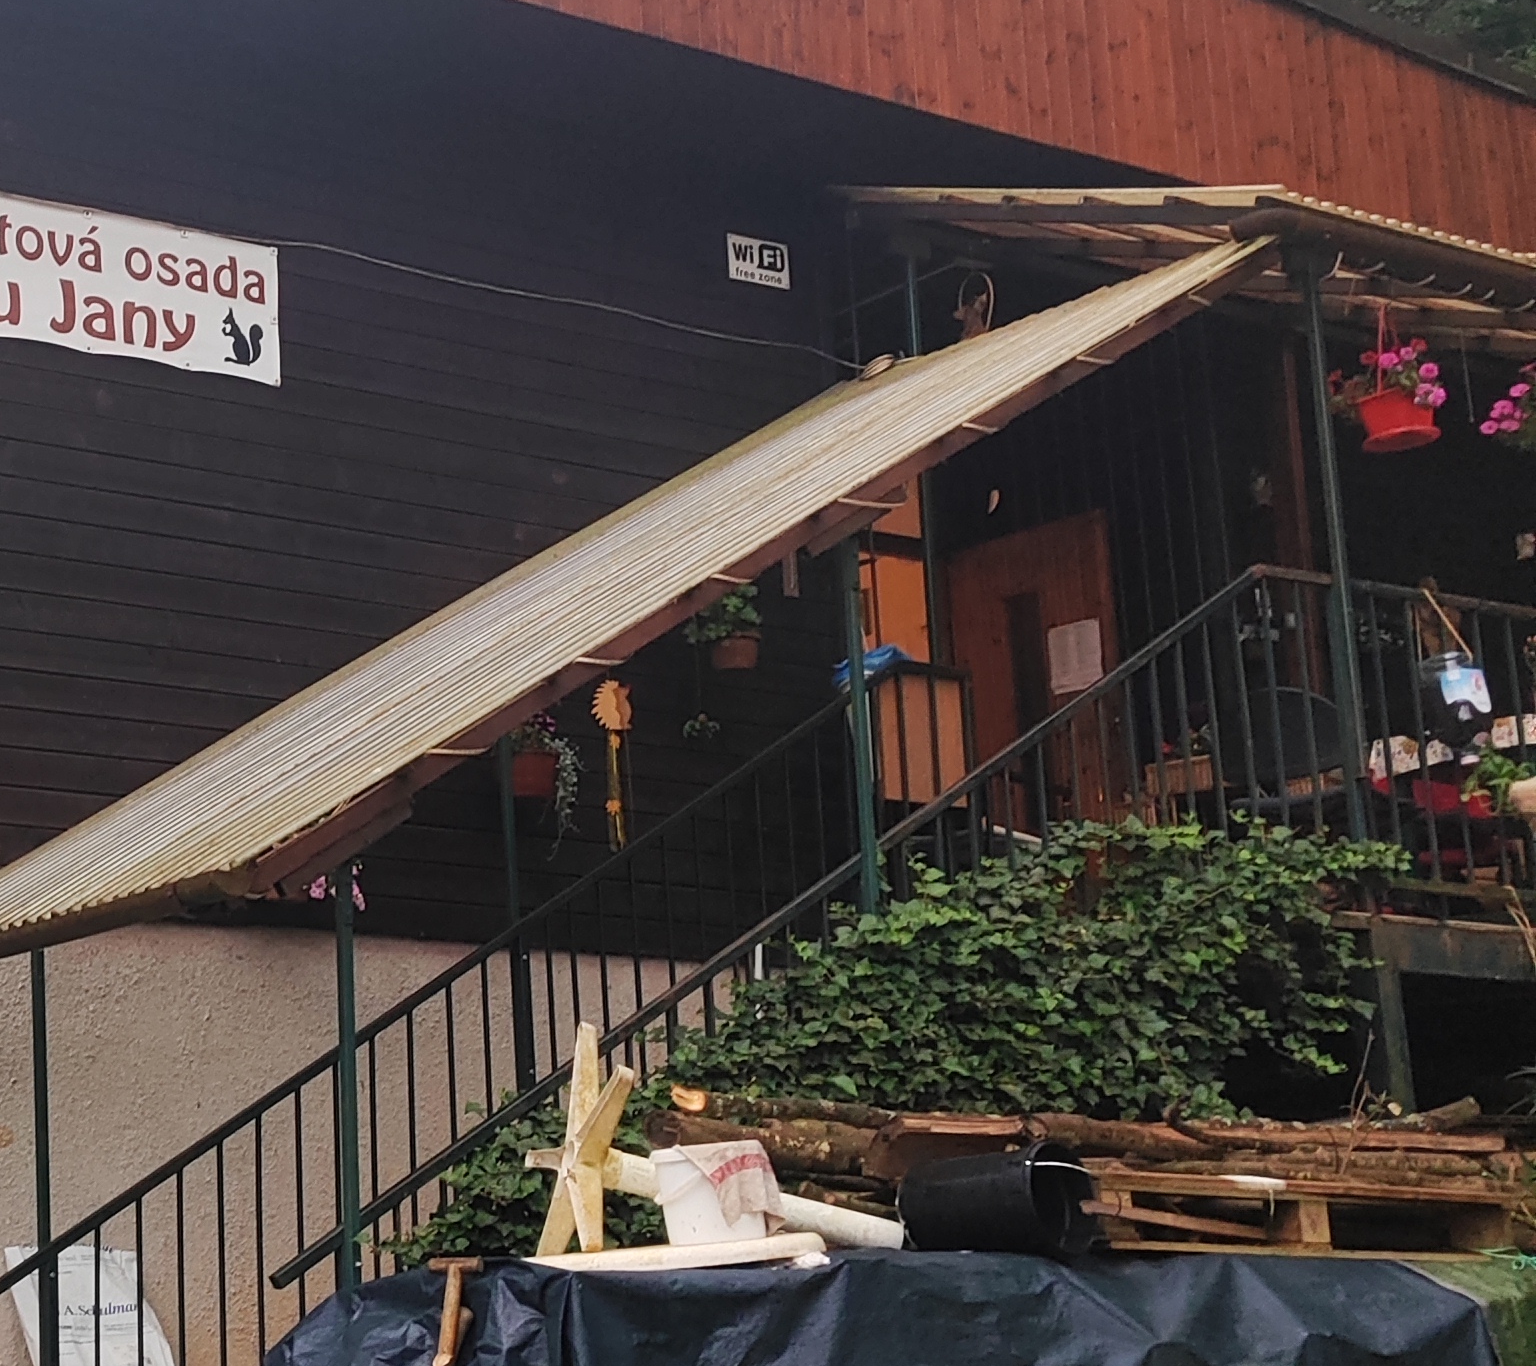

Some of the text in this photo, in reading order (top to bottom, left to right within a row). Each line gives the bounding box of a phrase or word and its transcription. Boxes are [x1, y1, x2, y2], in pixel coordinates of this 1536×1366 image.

[124, 247, 266, 305] osada
[736, 267, 782, 284] free zone
[49, 278, 196, 352] Jany
